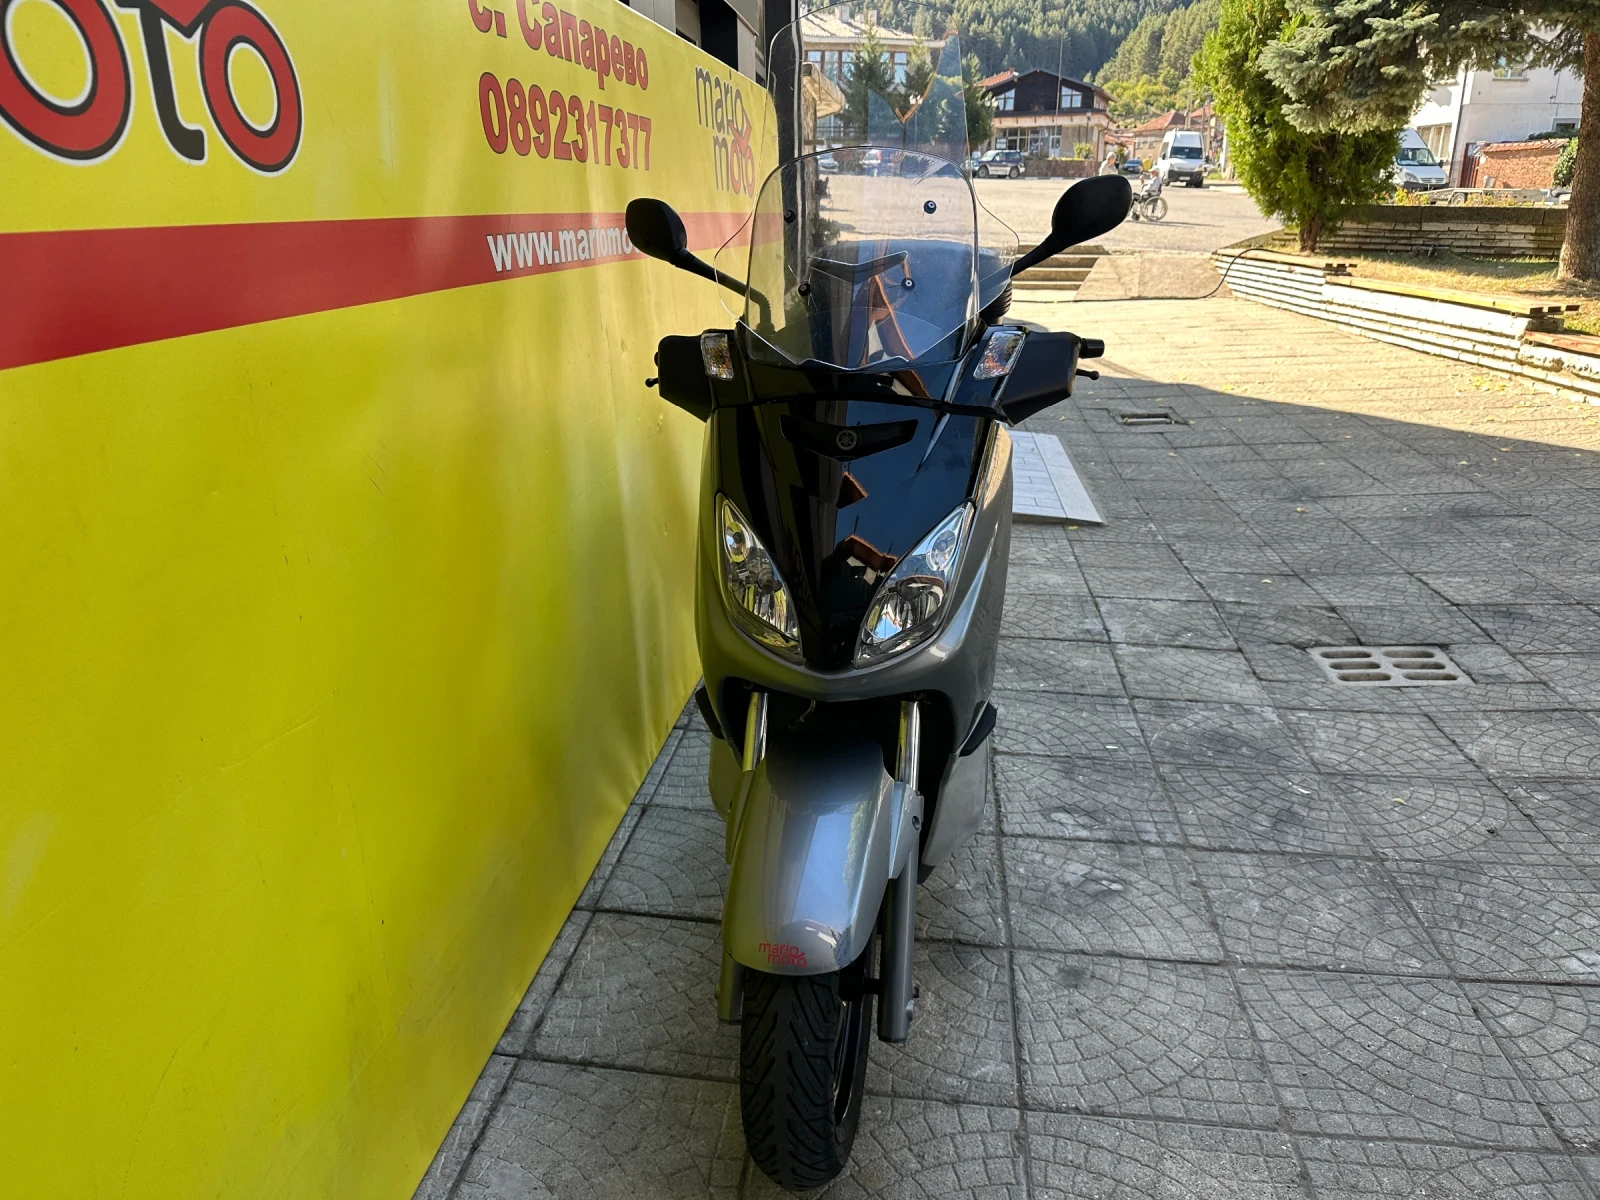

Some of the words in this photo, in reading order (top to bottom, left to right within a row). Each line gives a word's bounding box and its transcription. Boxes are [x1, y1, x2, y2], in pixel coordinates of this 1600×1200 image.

[516, 0, 648, 90] Сапарево
[479, 72, 651, 171] 0892317377
[694, 66, 745, 137] mario
[712, 134, 755, 198] moto
[486, 218, 640, 273] www.mariomo
[758, 942, 799, 956] mario
[767, 952, 807, 968] moto
